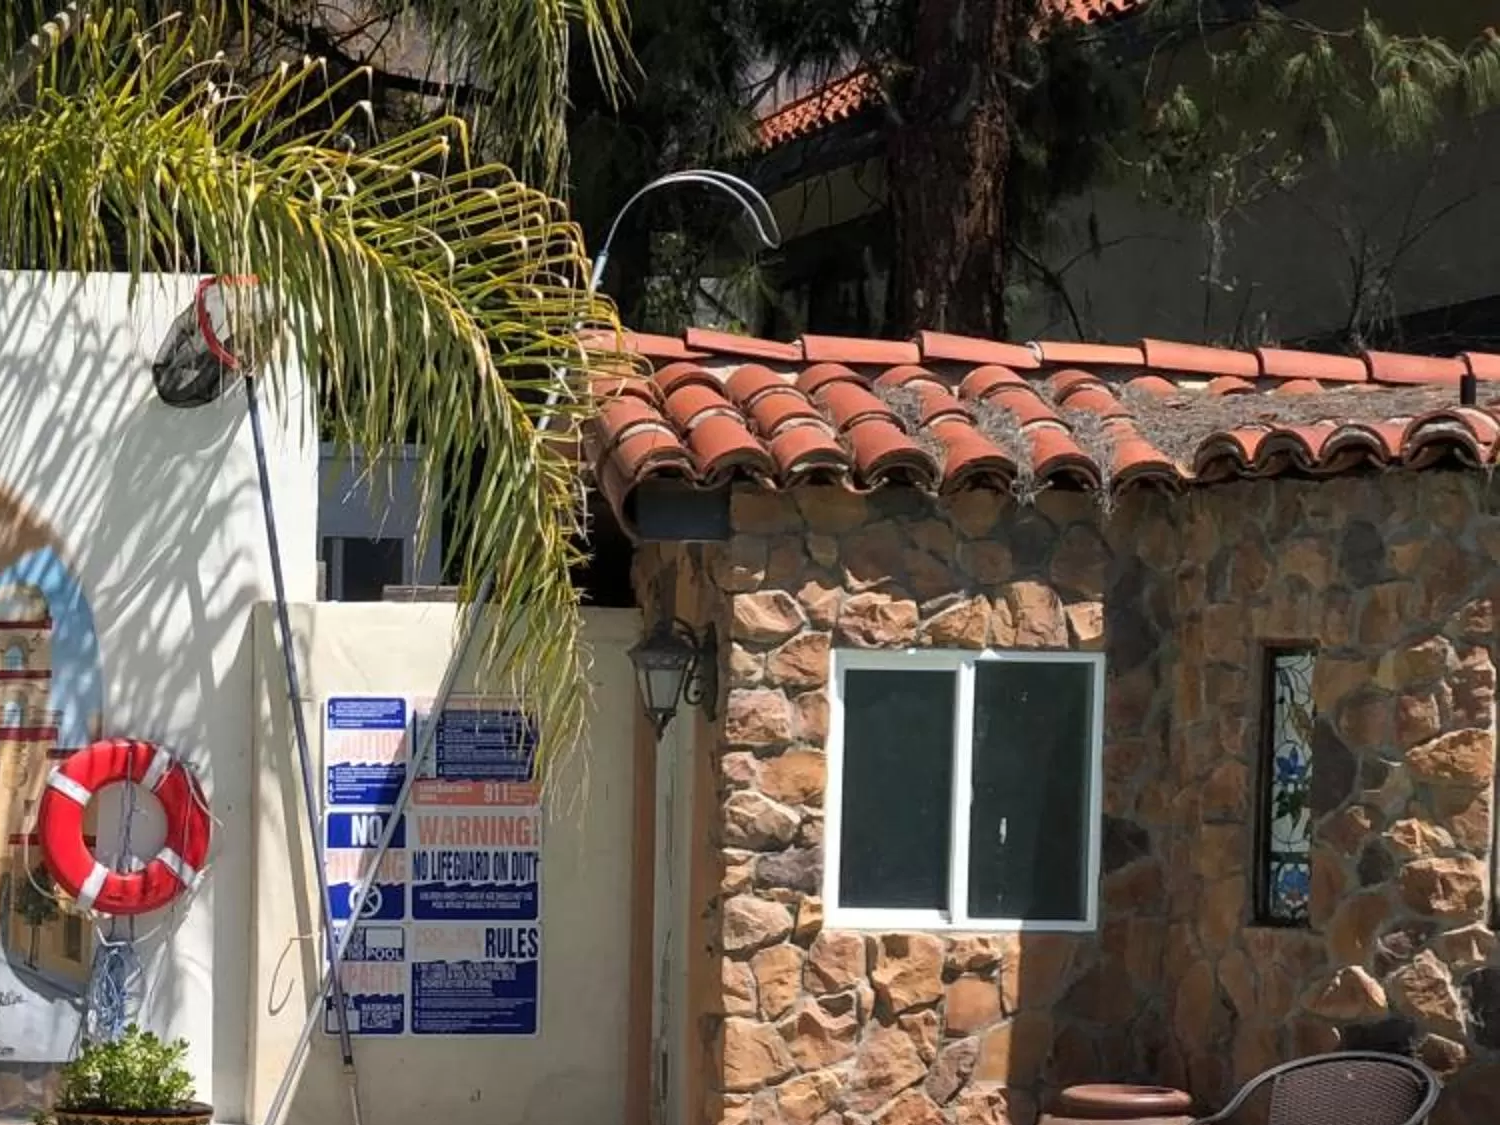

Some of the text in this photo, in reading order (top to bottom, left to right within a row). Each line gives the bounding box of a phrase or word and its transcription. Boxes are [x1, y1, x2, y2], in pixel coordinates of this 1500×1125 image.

[484, 782, 509, 804] 911
[352, 814, 384, 847] NO
[418, 815, 539, 846] WARNING!
[412, 850, 539, 881] NO LIFEGUARD ON DUTY
[365, 948, 404, 961] POOL
[484, 927, 539, 959] RULES
